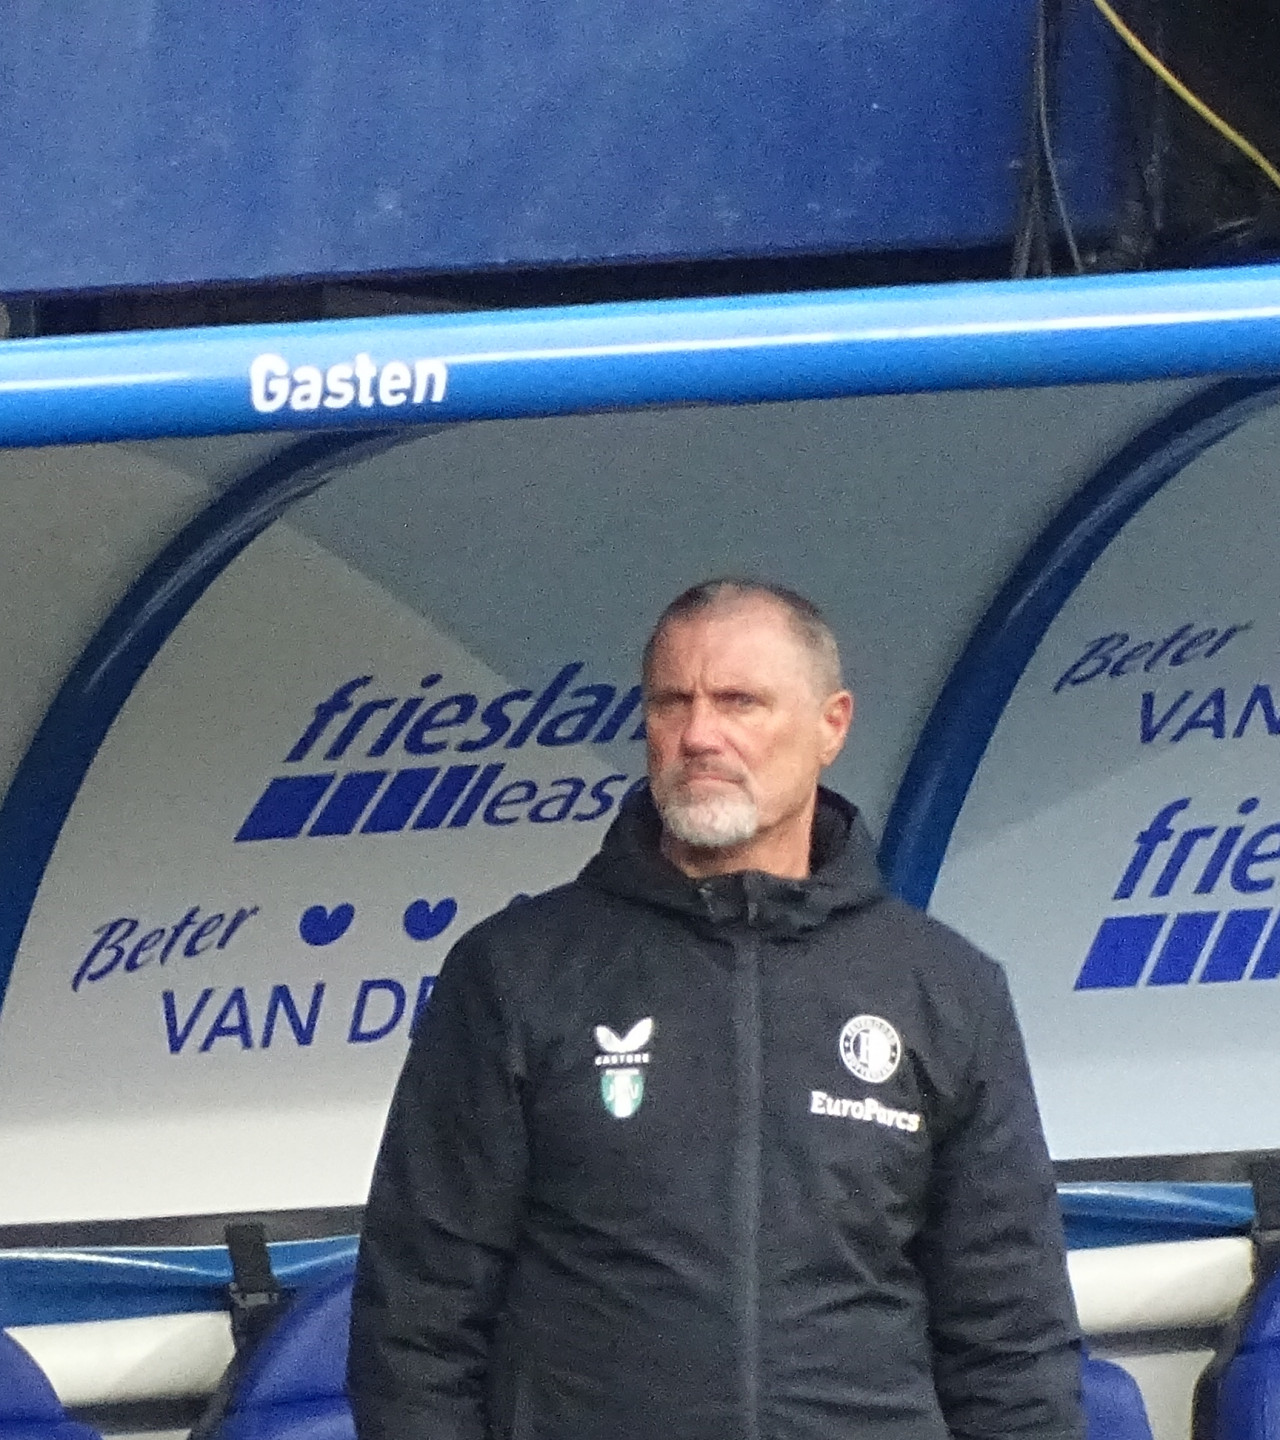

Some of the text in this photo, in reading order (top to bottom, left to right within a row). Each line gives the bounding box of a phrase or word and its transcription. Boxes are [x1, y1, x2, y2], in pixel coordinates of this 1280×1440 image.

[250, 353, 448, 413] Gasten
[1053, 622, 1250, 693] Beter
[284, 662, 647, 763] frieslan
[71, 904, 261, 992] Beter
[161, 981, 327, 1056] VAN
[811, 1091, 921, 1132] EuroParcs
